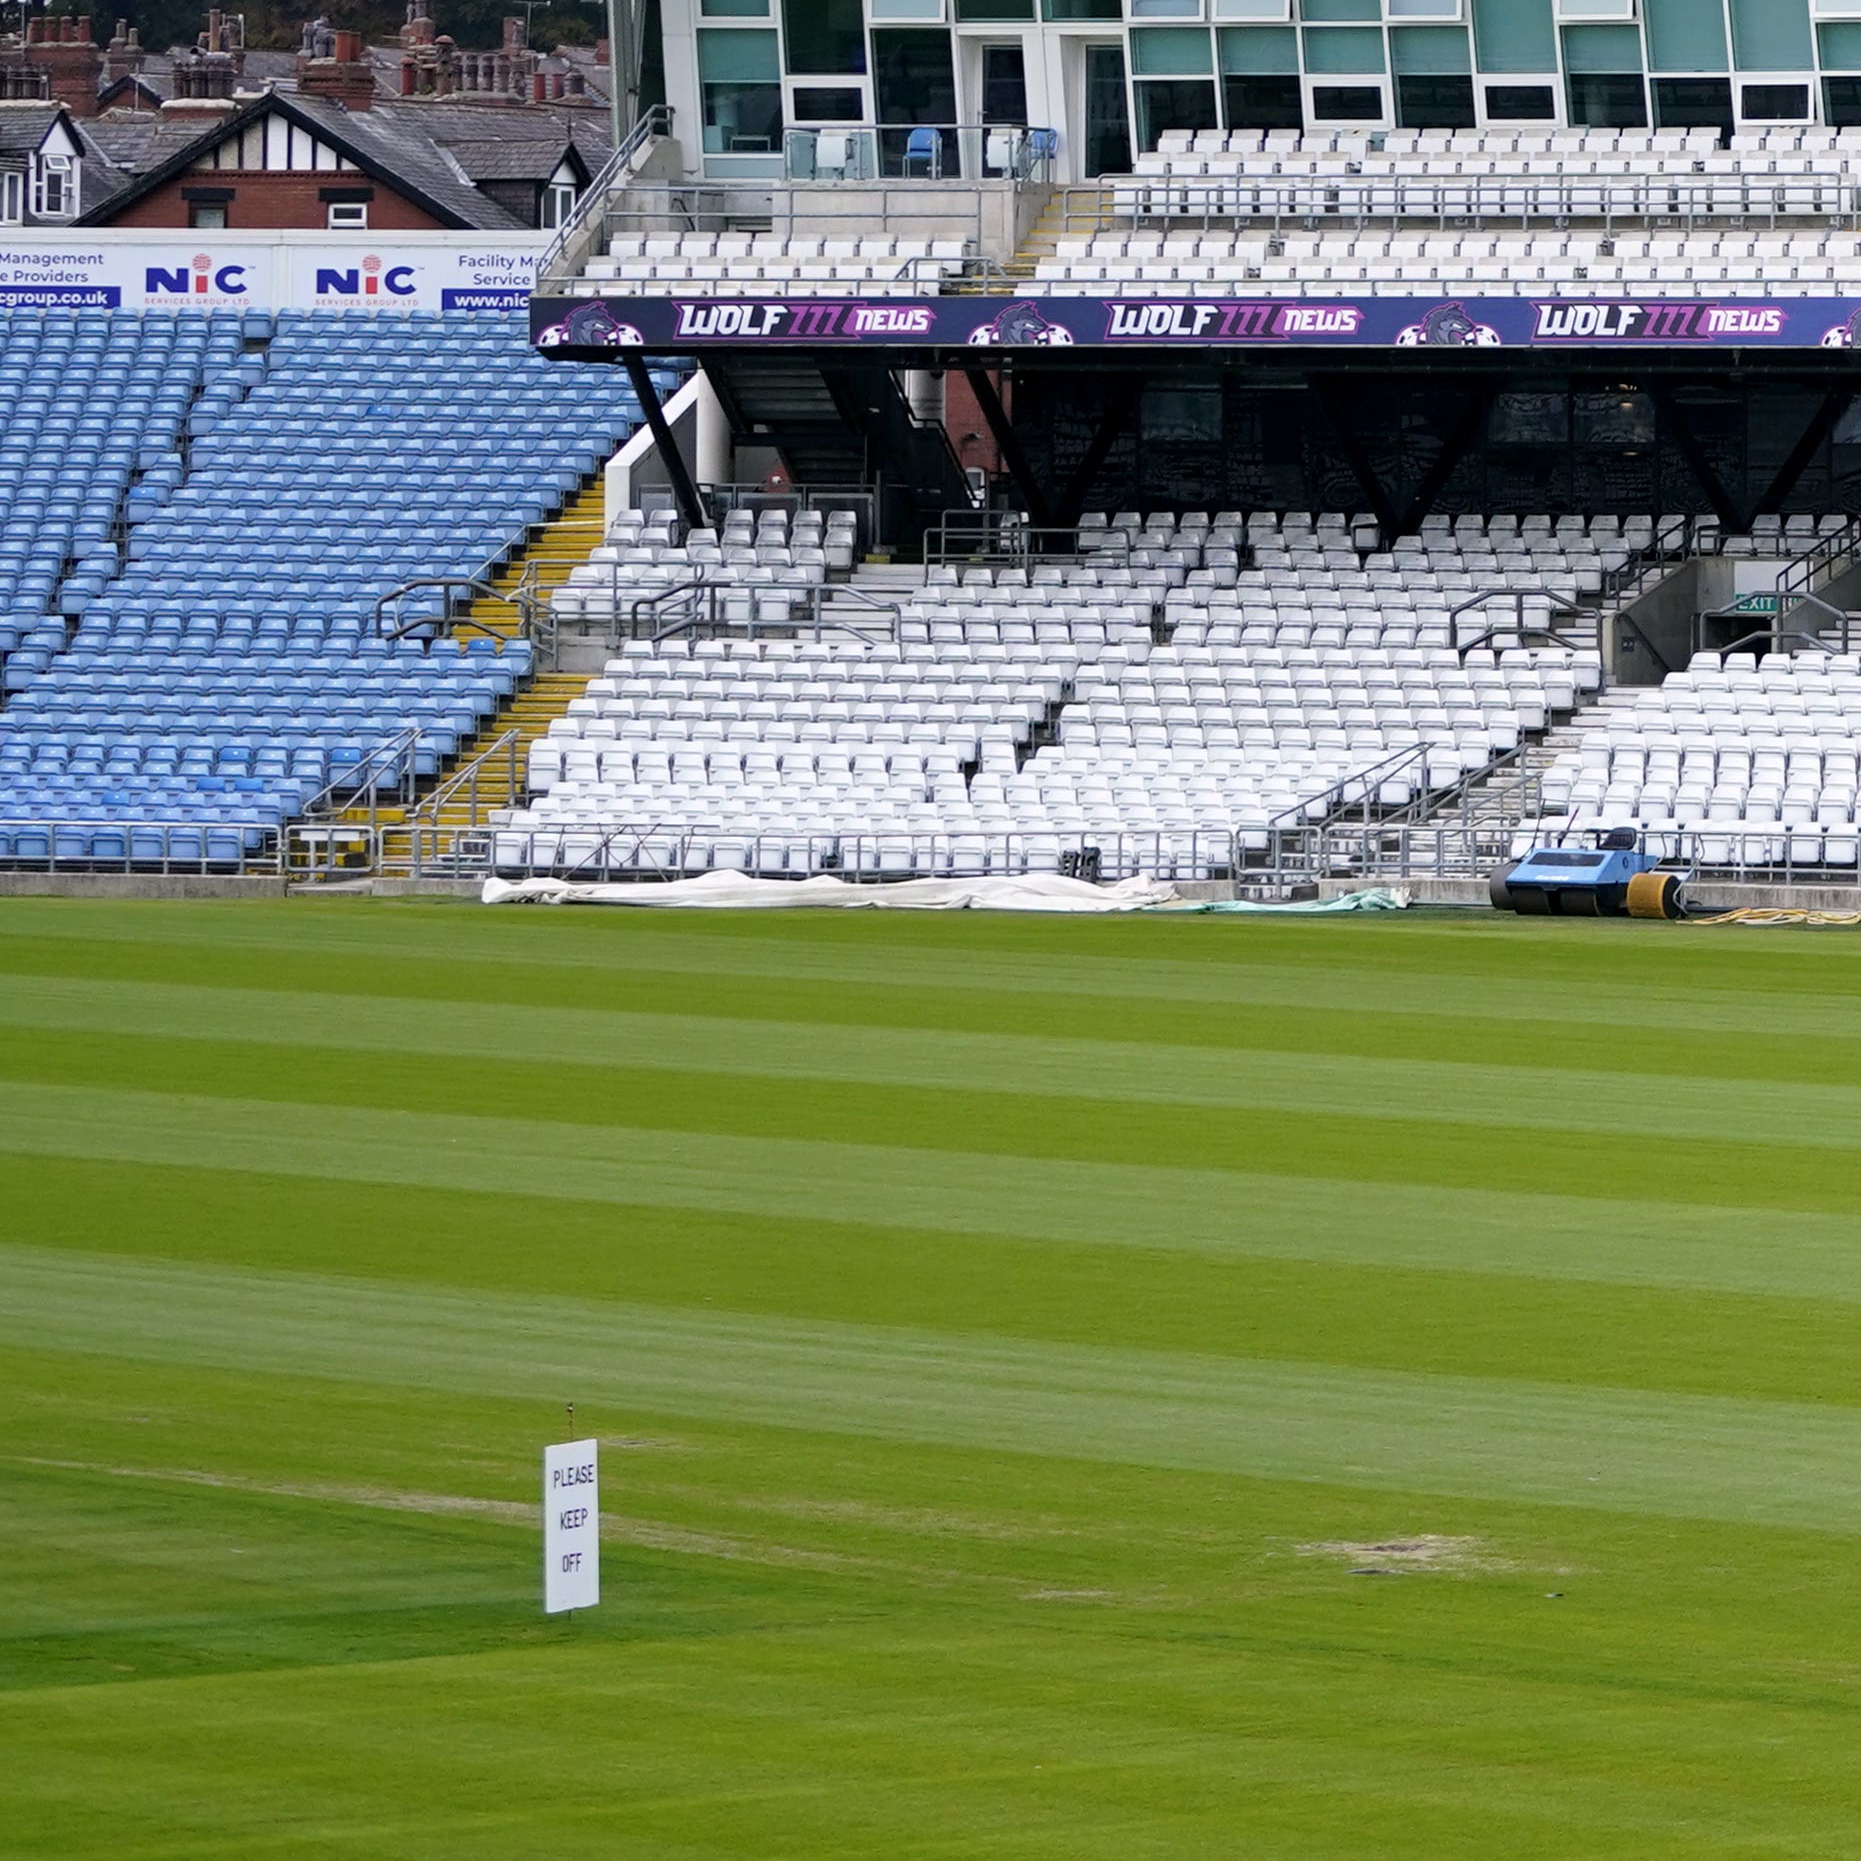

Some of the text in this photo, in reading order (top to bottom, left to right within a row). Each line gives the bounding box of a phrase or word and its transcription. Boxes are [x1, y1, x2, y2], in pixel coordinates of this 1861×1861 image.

[0, 253, 104, 267] Management
[458, 254, 515, 270] Facility
[14, 270, 88, 282] Providers
[473, 273, 531, 285] Service
[855, 309, 930, 332] NEWS
[1284, 309, 1357, 332] NEWS
[1708, 309, 1783, 332] NEWS
[554, 1464, 594, 1488] PLEASE
[560, 1508, 588, 1530] KEEP
[562, 1553, 582, 1573] OFF
